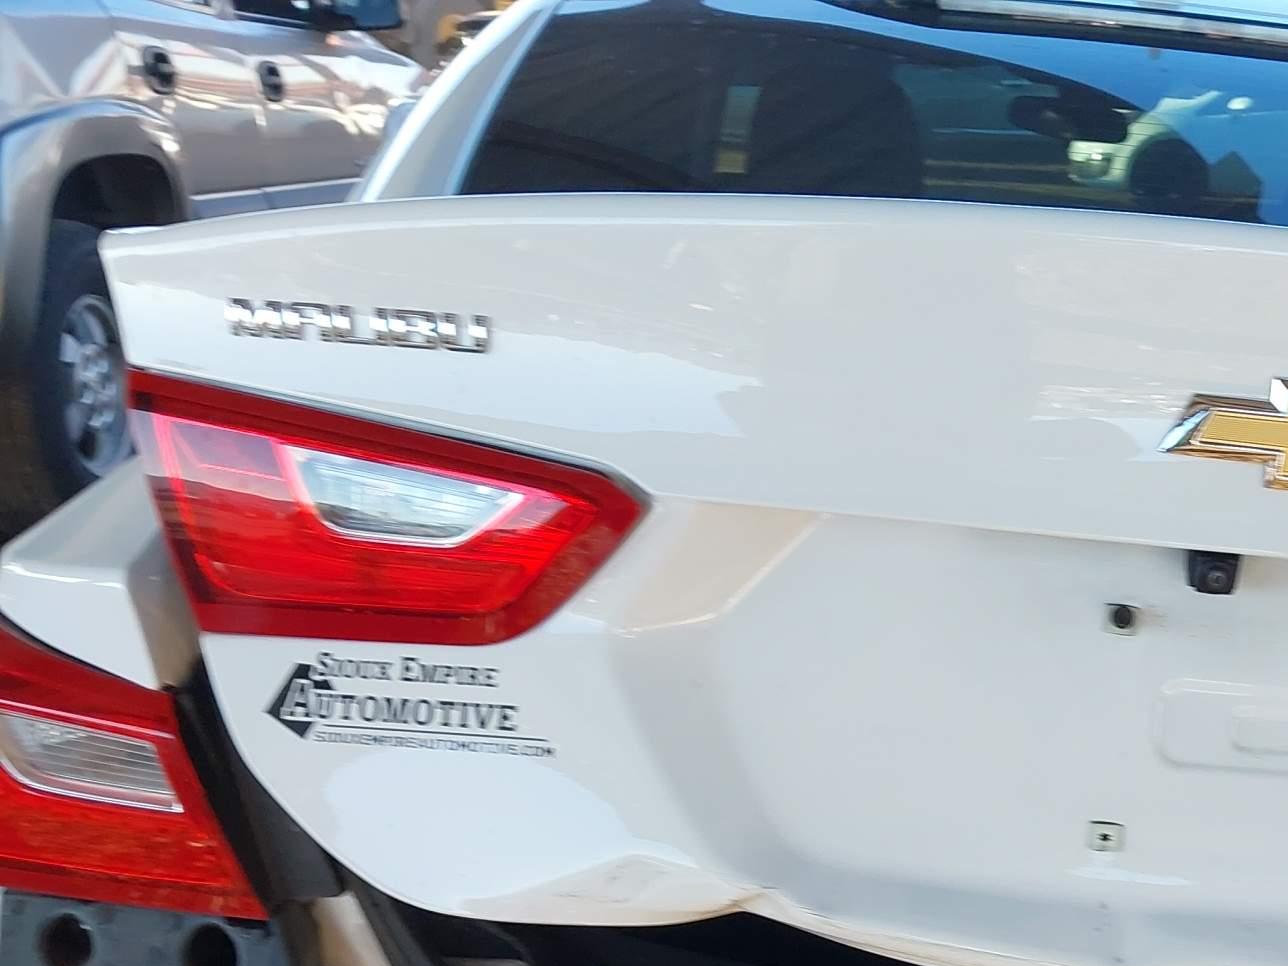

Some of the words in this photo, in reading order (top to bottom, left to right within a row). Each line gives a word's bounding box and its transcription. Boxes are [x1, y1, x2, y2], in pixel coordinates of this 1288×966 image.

[224, 297, 491, 354] MALIBU
[400, 656, 500, 688] EMPIRE
[279, 678, 520, 732] AUTOMOTIVE
